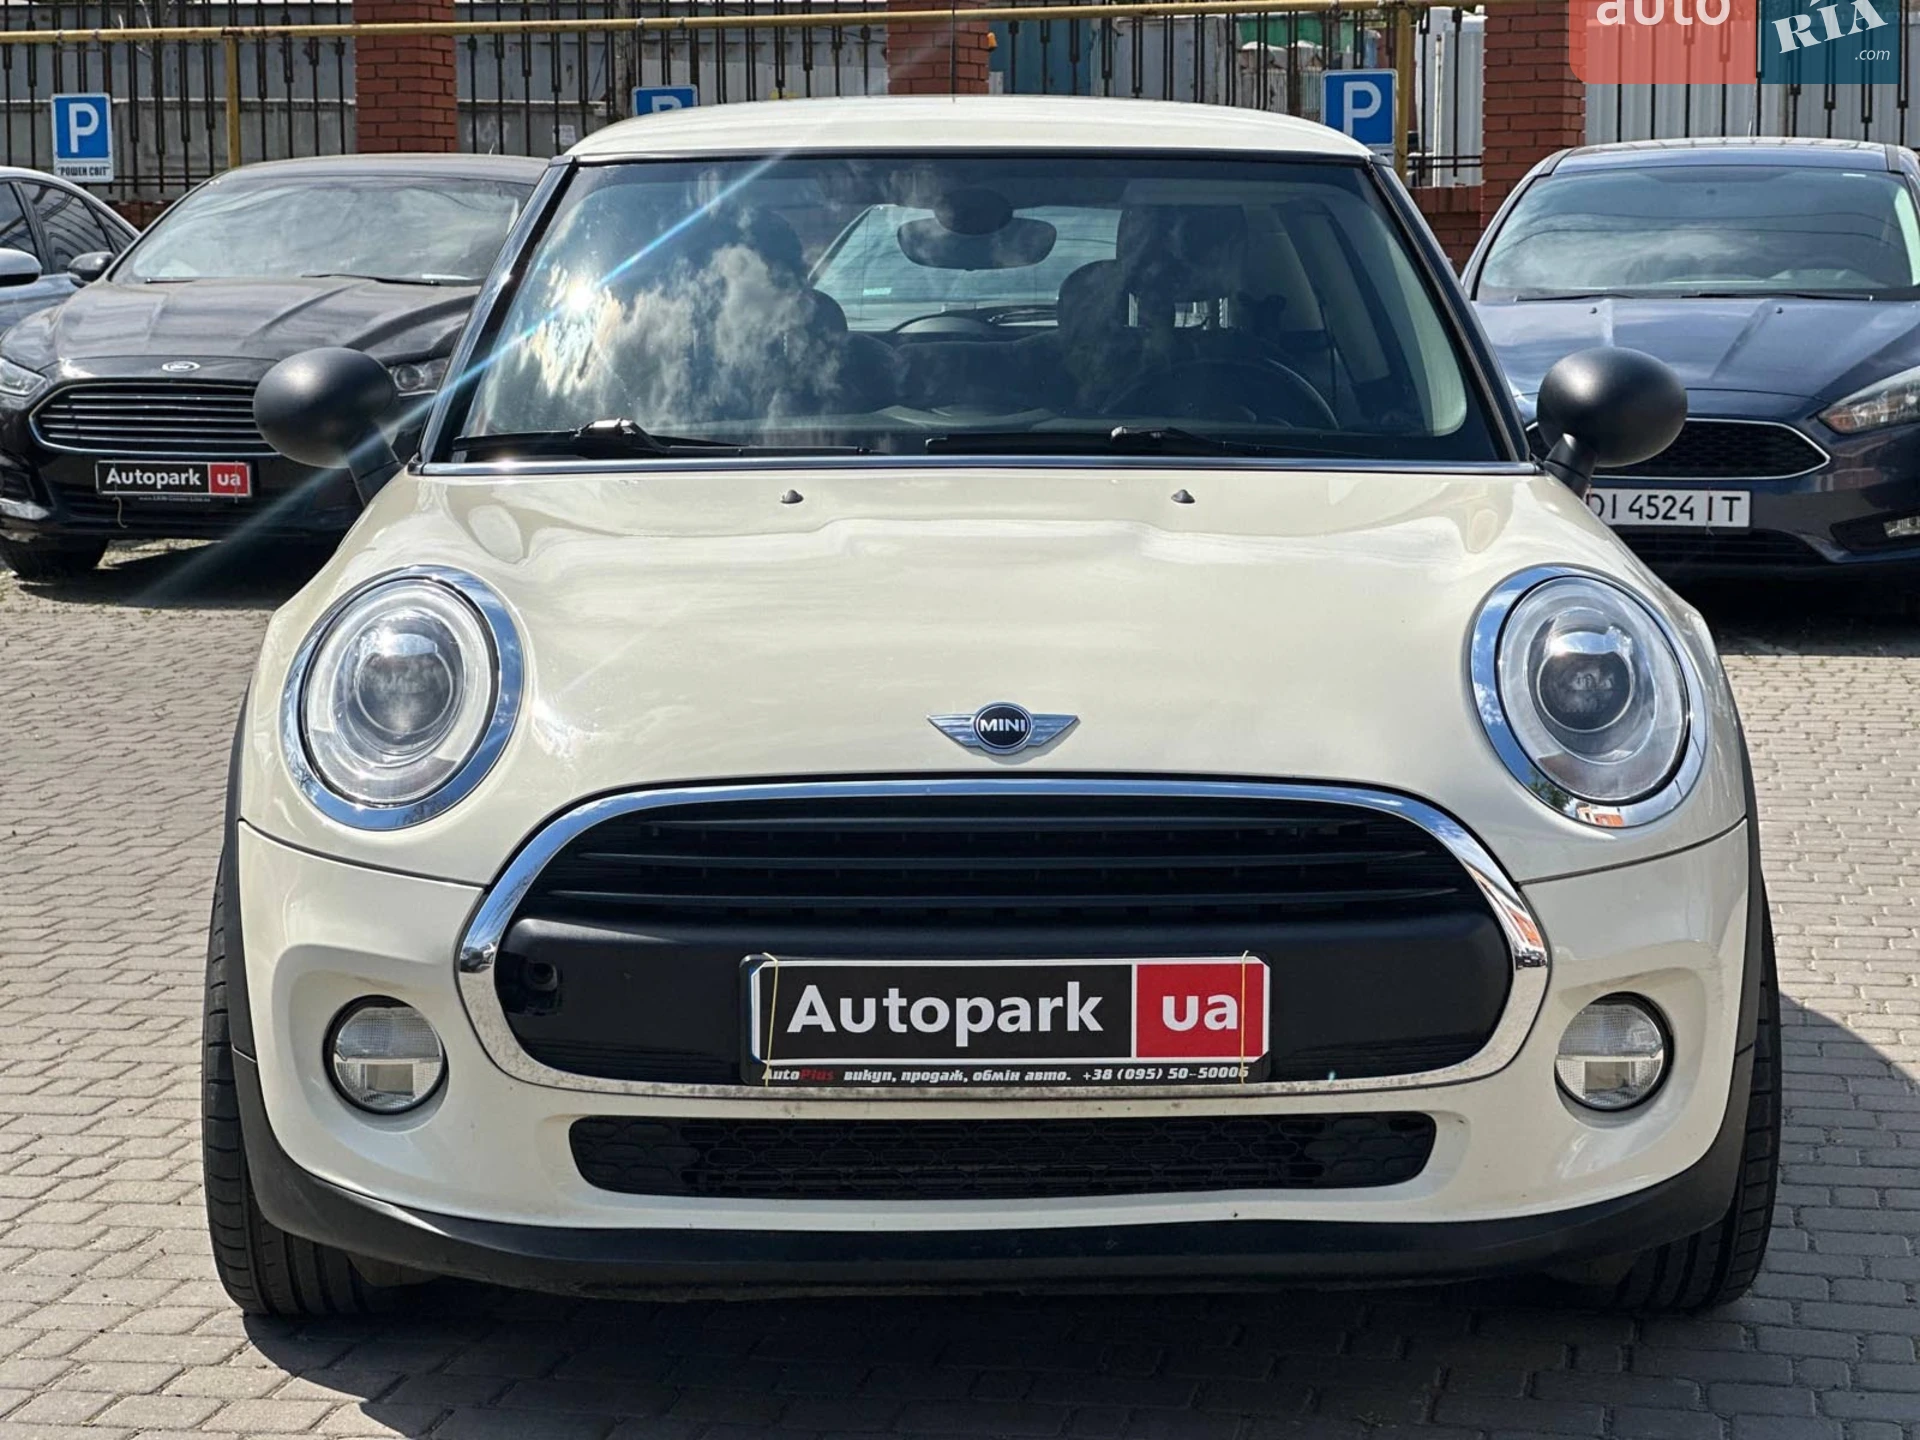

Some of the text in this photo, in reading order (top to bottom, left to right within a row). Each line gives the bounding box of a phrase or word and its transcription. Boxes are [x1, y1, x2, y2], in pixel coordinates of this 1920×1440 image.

[1343, 81, 1382, 137] P
[68, 102, 99, 154] P
[106, 468, 241, 489] Autopark ua
[1628, 494, 1694, 521] 4524
[1708, 496, 1741, 522] IT
[980, 718, 1025, 732] MINI
[787, 981, 1238, 1047] Autopark ua
[762, 1068, 834, 1082] AutoPlus
[844, 1069, 897, 1083] викуп,
[901, 1069, 968, 1083] продаж,
[973, 1070, 1020, 1082] обмін
[1025, 1071, 1071, 1081] авто.
[1083, 1068, 1112, 1080] +38
[1117, 1067, 1163, 1081] (095)
